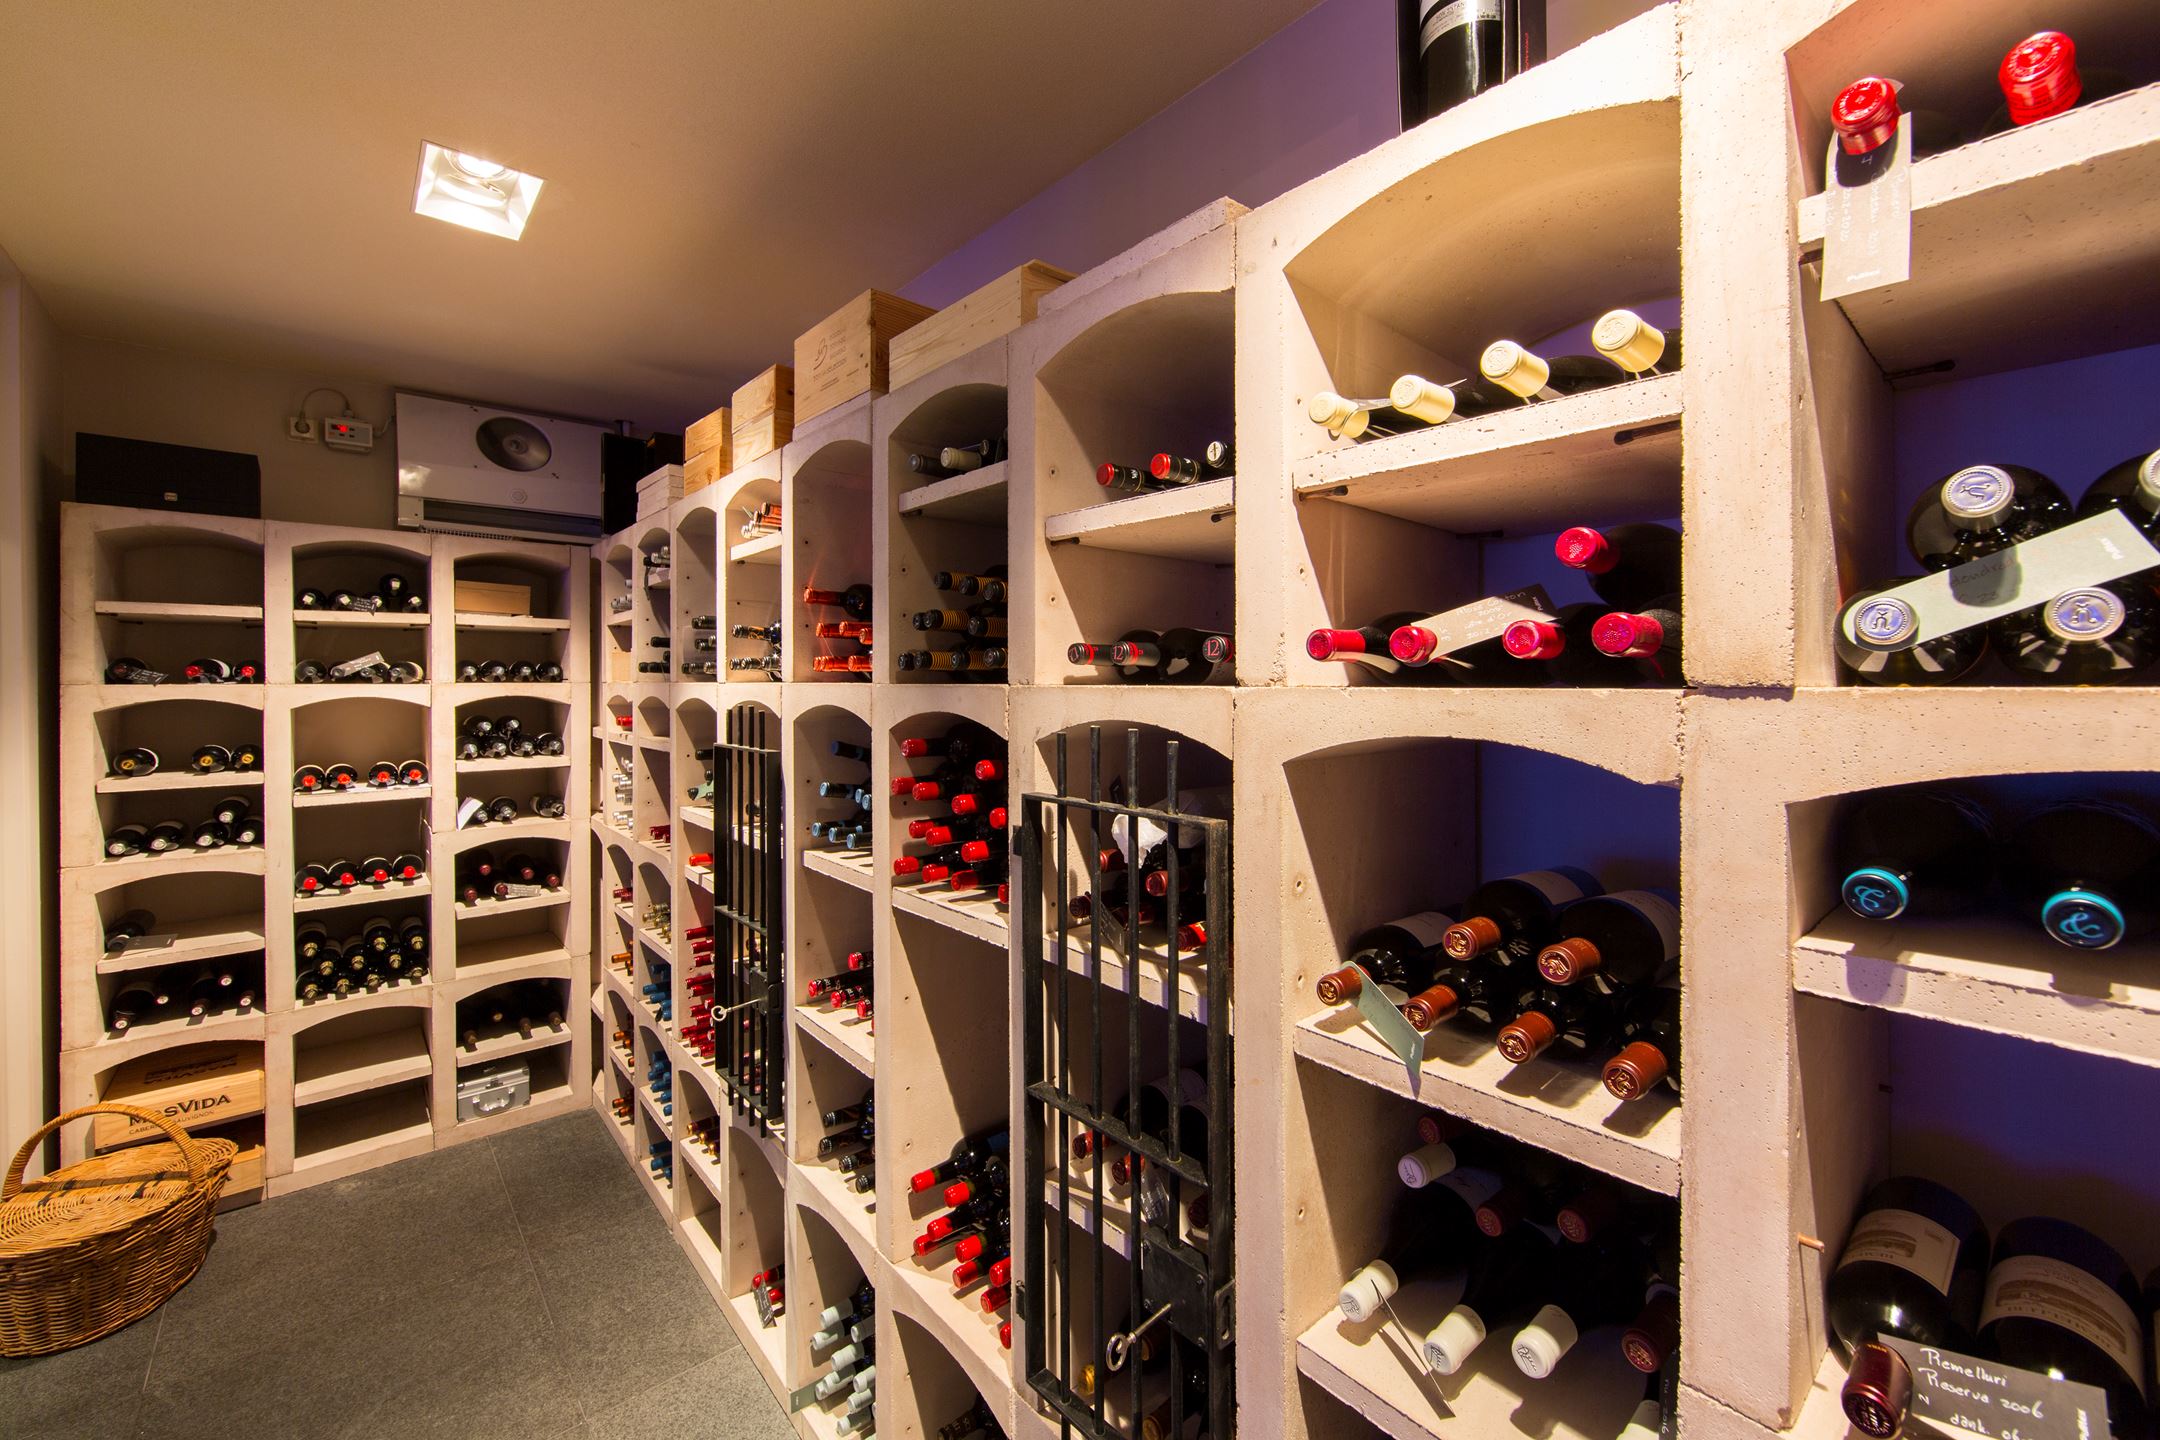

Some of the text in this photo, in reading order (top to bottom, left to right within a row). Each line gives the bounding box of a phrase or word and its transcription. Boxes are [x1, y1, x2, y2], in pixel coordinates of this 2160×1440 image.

[1113, 645, 1124, 661] 12
[1205, 639, 1221, 657] 12
[1920, 1347, 2007, 1387] Remelluri
[1918, 1368, 2044, 1419] Reserva 2006
